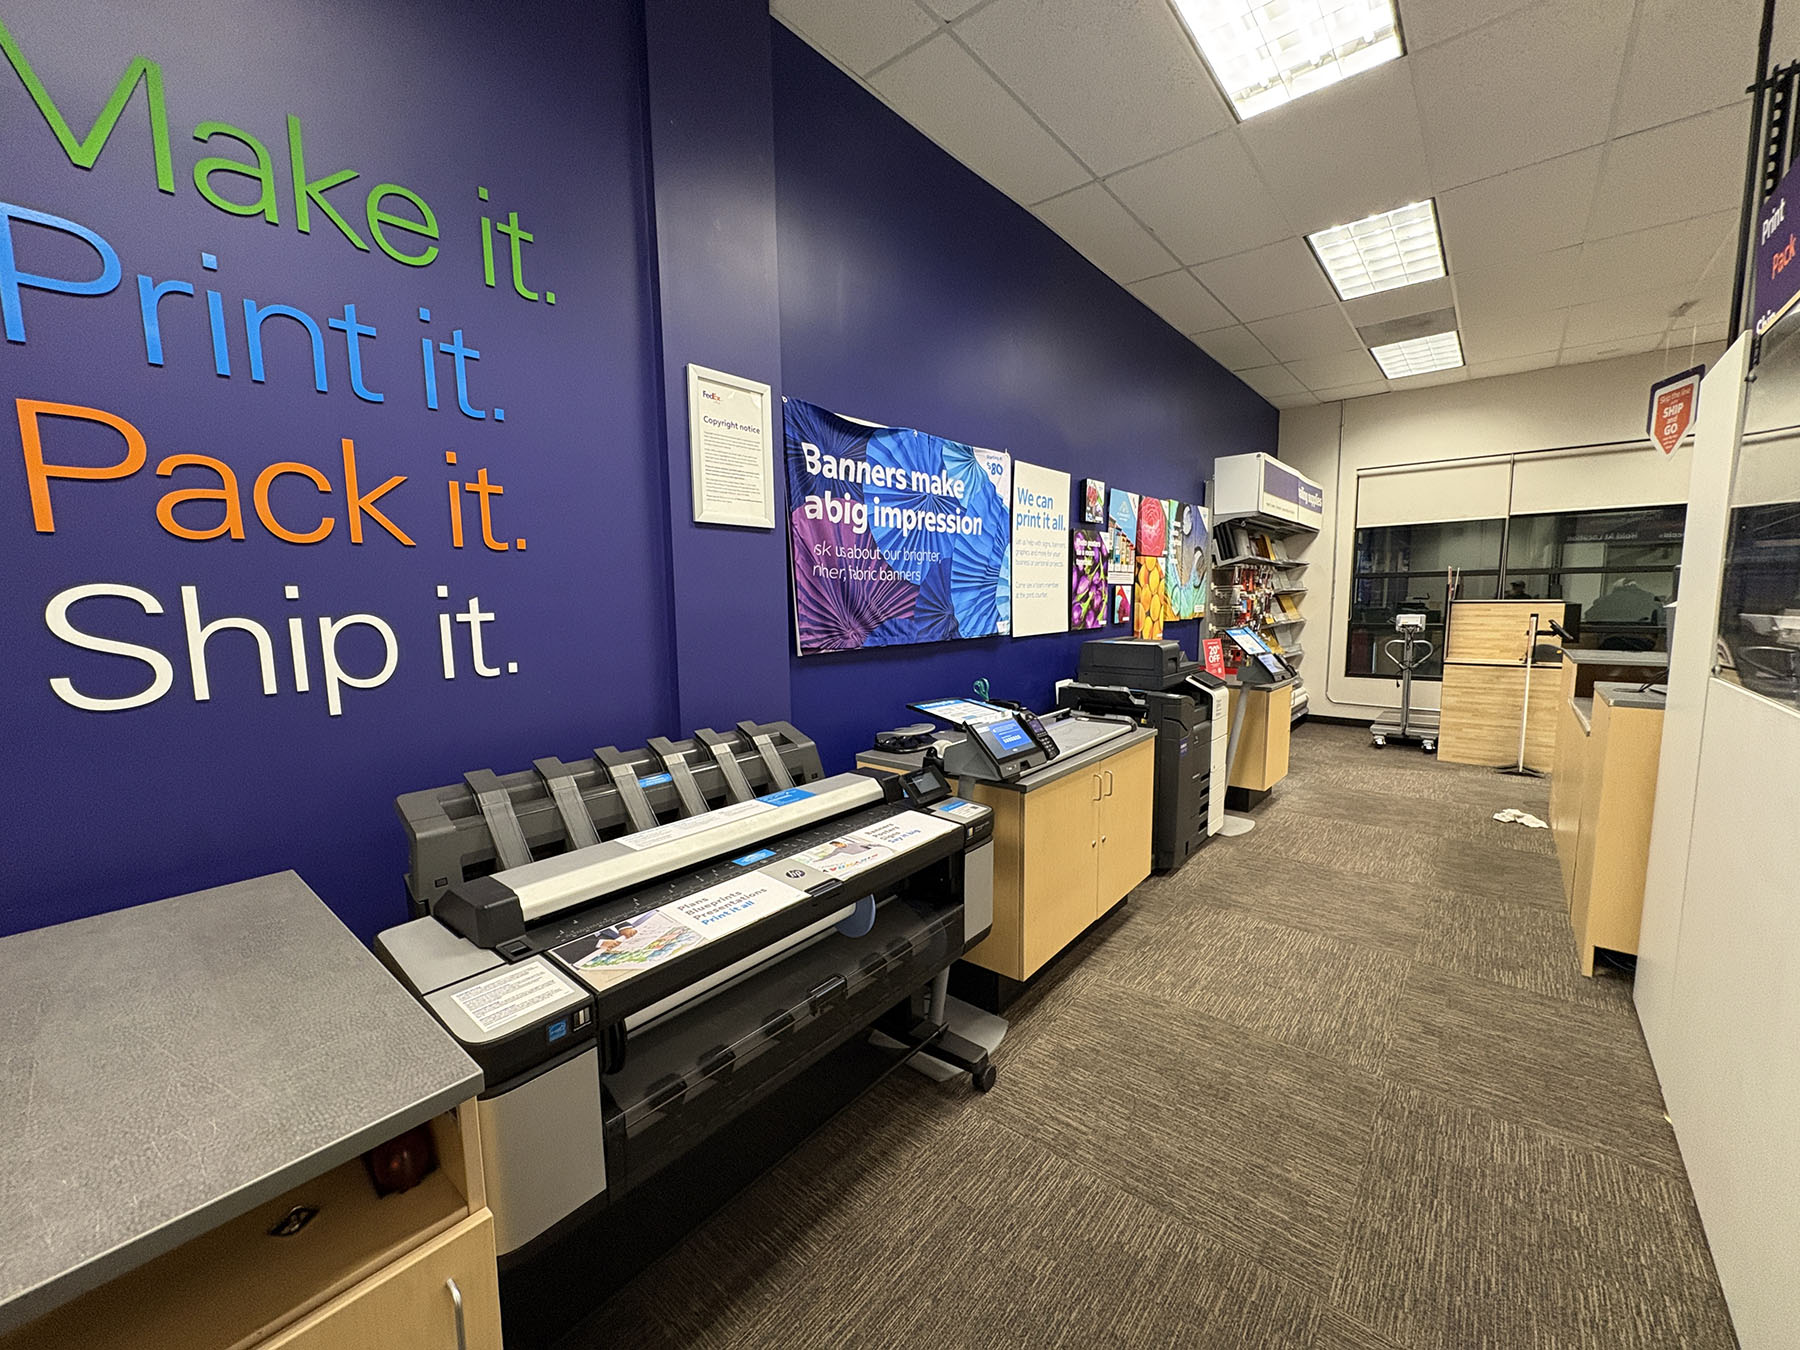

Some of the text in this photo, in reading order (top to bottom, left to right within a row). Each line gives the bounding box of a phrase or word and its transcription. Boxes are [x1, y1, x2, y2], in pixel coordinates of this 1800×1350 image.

[0, 18, 556, 304] Make it.
[1761, 197, 1786, 246] Print
[1771, 233, 1797, 281] Pack
[0, 204, 505, 421] Print it.
[702, 390, 721, 401] FedEx
[1662, 402, 1684, 418] SHIP
[703, 415, 761, 434] Copyright notice
[1664, 423, 1678, 436] GO
[16, 397, 527, 551] Pack it.
[801, 442, 907, 490] Banners
[911, 470, 965, 499] make
[986, 461, 1004, 476] $80
[1017, 487, 1053, 510] We can
[804, 490, 982, 537] a big impression
[1016, 510, 1066, 531] print it all.
[847, 544, 881, 560] about
[883, 550, 901, 561] our
[903, 547, 942, 565] brighter,
[45, 582, 519, 716] Ship it.
[1208, 655, 1221, 664] OFF
[790, 869, 804, 879] hp
[677, 897, 708, 911] Plans
[685, 891, 742, 916] Blueprints
[692, 887, 768, 921] Presentations
[701, 911, 732, 926] Print
[741, 900, 755, 909] all
